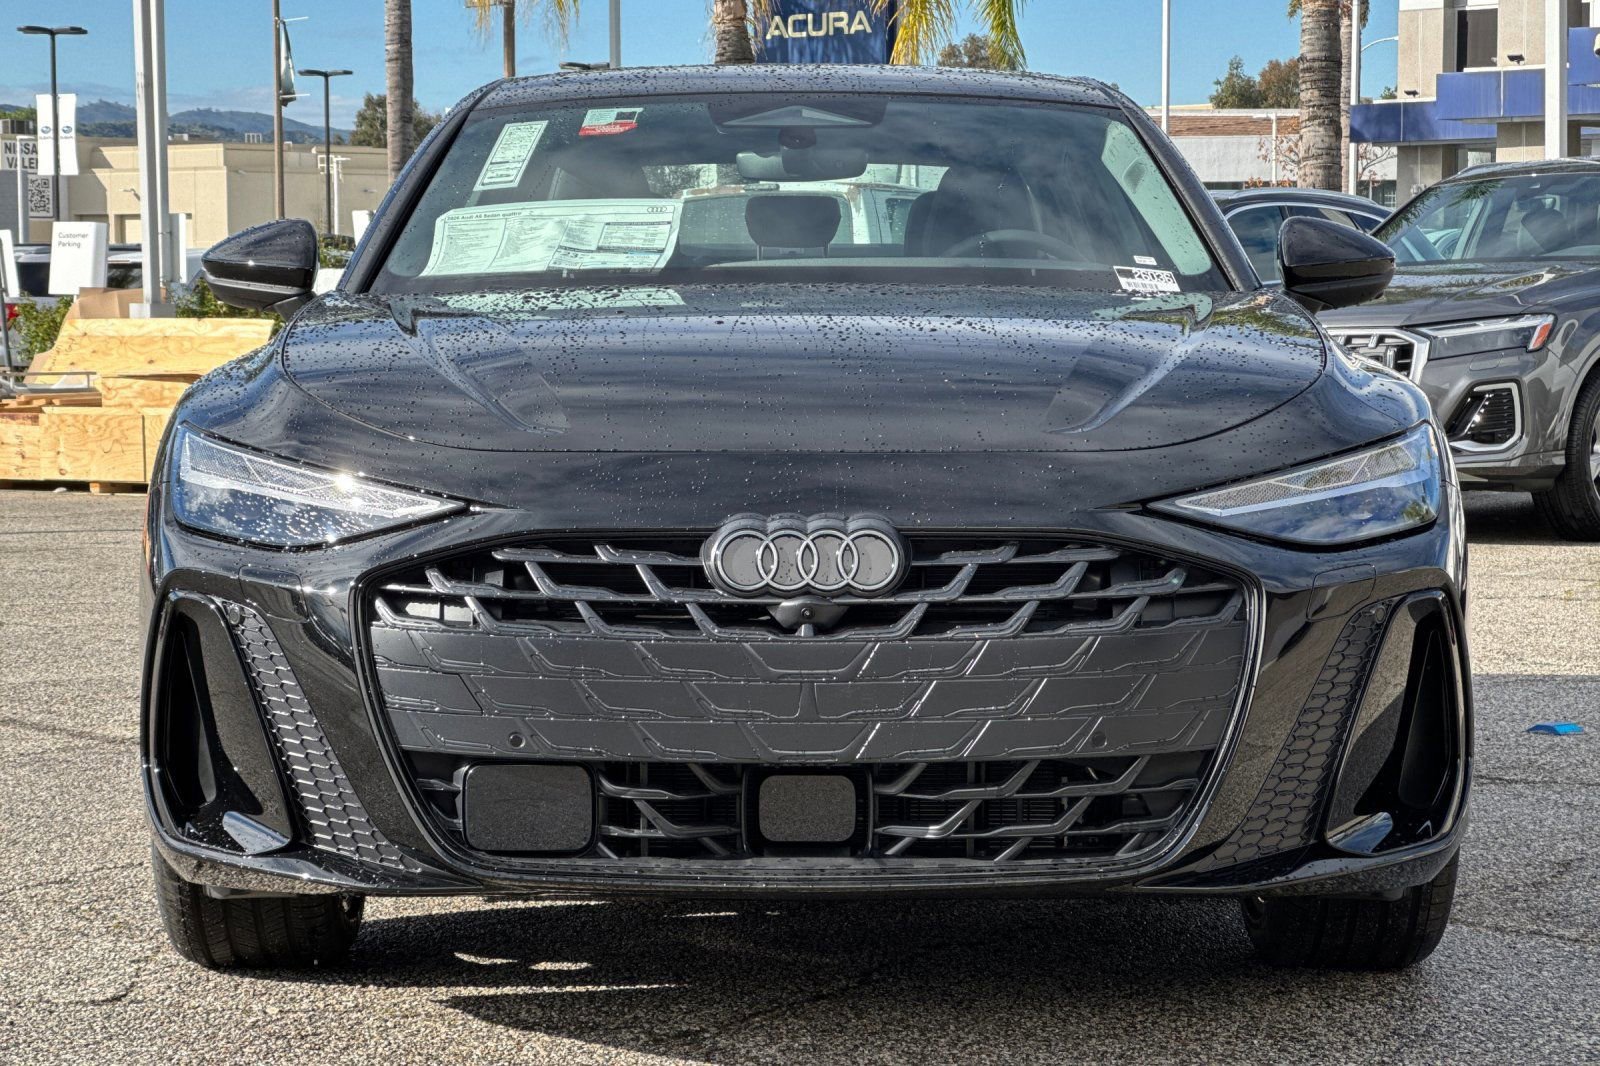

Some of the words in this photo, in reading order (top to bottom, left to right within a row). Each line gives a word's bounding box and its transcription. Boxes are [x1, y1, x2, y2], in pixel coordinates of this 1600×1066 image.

[766, 10, 873, 40] ACURA
[58, 231, 89, 239] Customer
[57, 240, 81, 249] Parking
[1134, 269, 1174, 284] 26036
